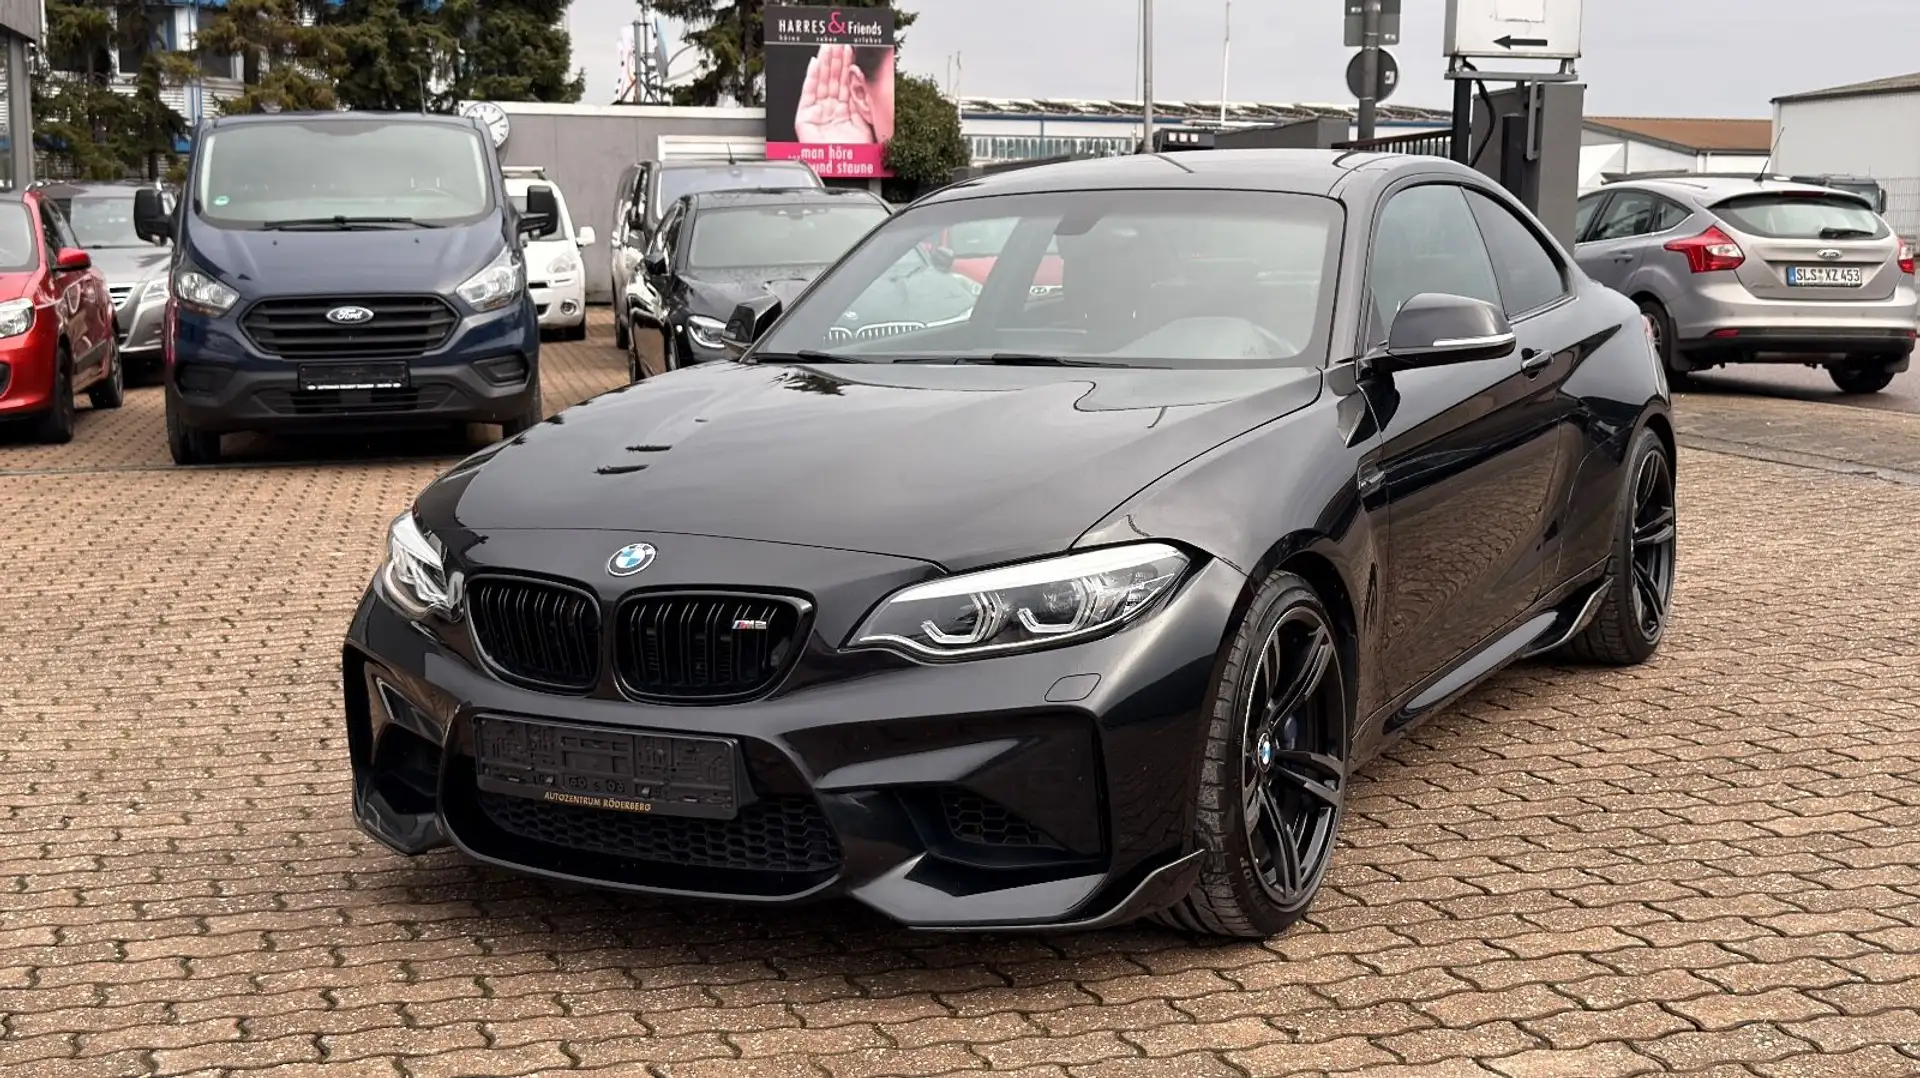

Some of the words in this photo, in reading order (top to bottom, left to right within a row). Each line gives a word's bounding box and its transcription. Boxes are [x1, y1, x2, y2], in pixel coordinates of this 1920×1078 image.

[779, 19, 825, 34] HARRES
[828, 11, 846, 34] &
[847, 21, 882, 35] Friends
[828, 144, 853, 160] höre
[836, 161, 874, 174] staune
[1796, 268, 1817, 281] SLS
[1825, 269, 1838, 281] XZ
[1841, 269, 1860, 282] 453
[544, 791, 601, 806] AUTOZENTRUM
[603, 798, 652, 812] RÖDERBERG
